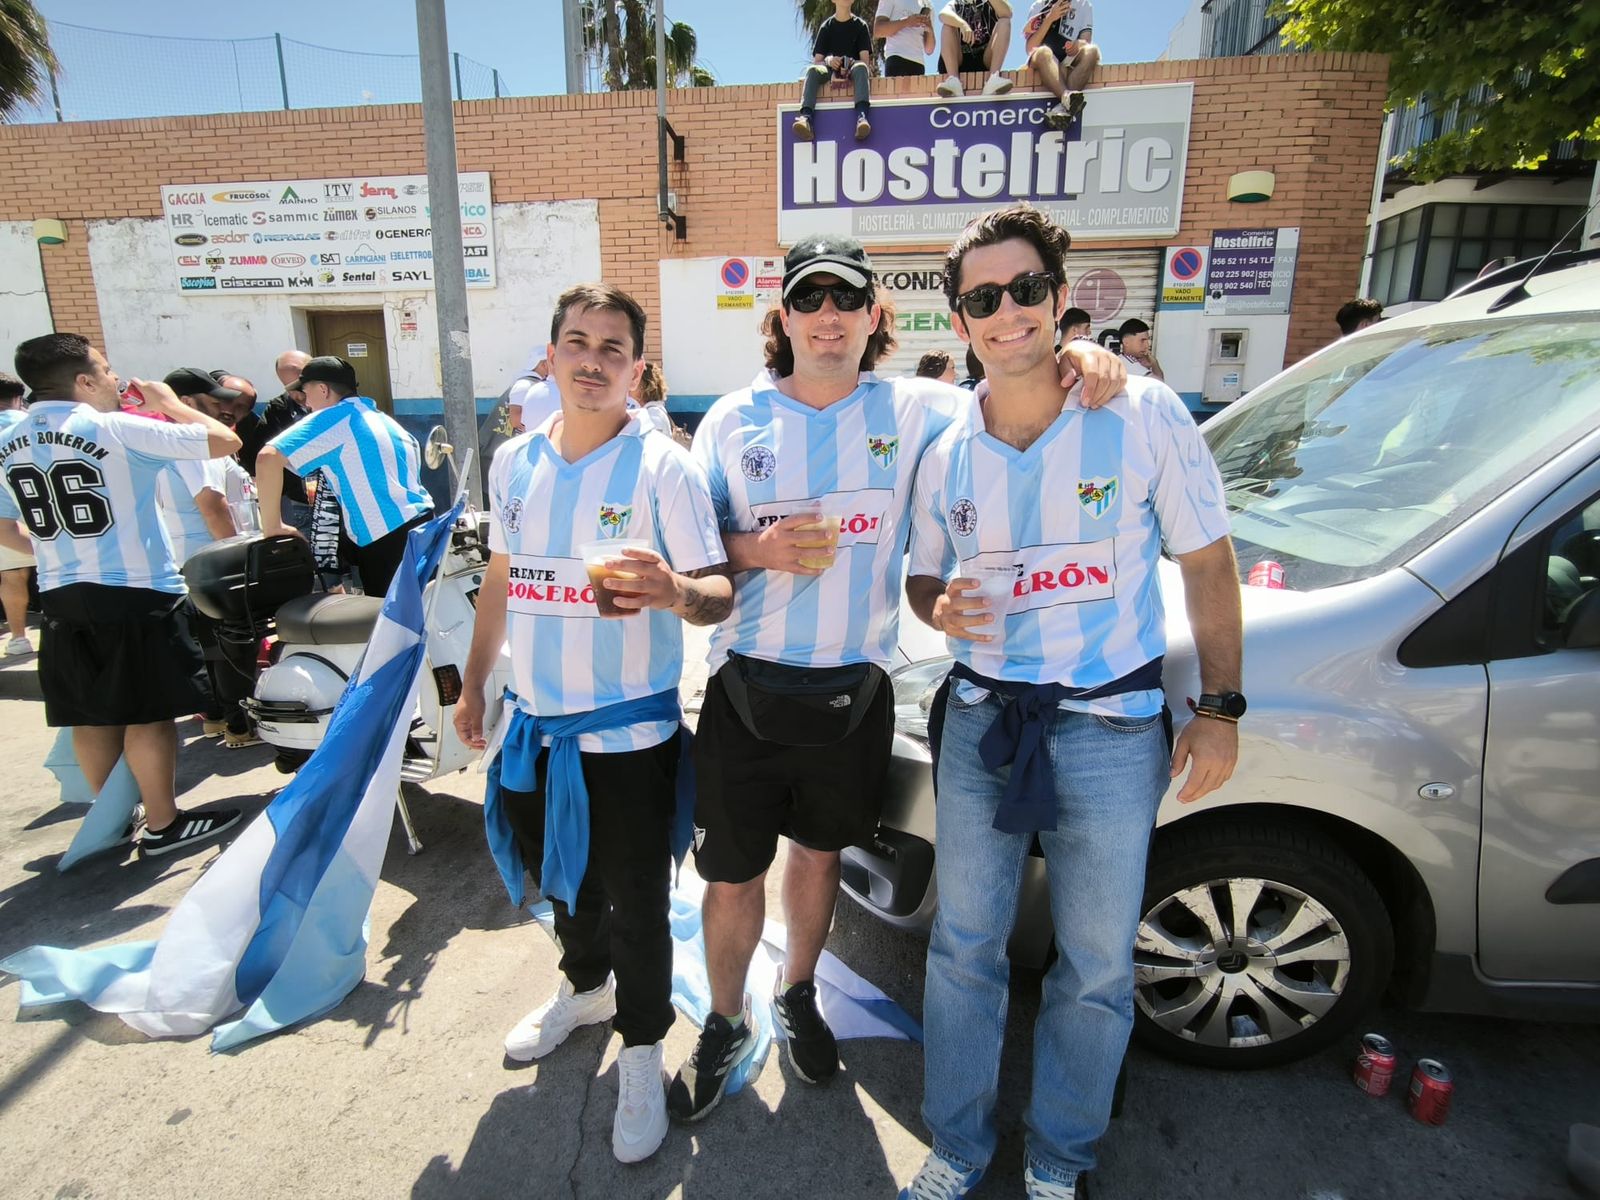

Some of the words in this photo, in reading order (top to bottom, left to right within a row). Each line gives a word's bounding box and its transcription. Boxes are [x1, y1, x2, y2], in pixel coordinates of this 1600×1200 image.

[929, 101, 1077, 128] Comerc
[793, 128, 1173, 204] Hostelfric
[229, 191, 271, 200] FRUCOSOL
[324, 184, 352, 196] ITV
[168, 192, 206, 205] GAGGIA
[377, 206, 417, 215] SILANOS
[1088, 207, 1169, 226] COMPLEMENTOS
[204, 212, 248, 226] Icematic
[269, 212, 319, 222] sammic
[859, 210, 915, 232] HOSTELERÍA
[385, 228, 432, 239] GENERA
[1214, 236, 1274, 248] Hostelfric
[229, 255, 268, 265] ZUMMO
[1227, 257, 1237, 265] 52
[342, 271, 376, 282] Sental
[37, 431, 109, 461] BOKERON
[6, 459, 115, 542] 86
[508, 567, 556, 582] RENTE
